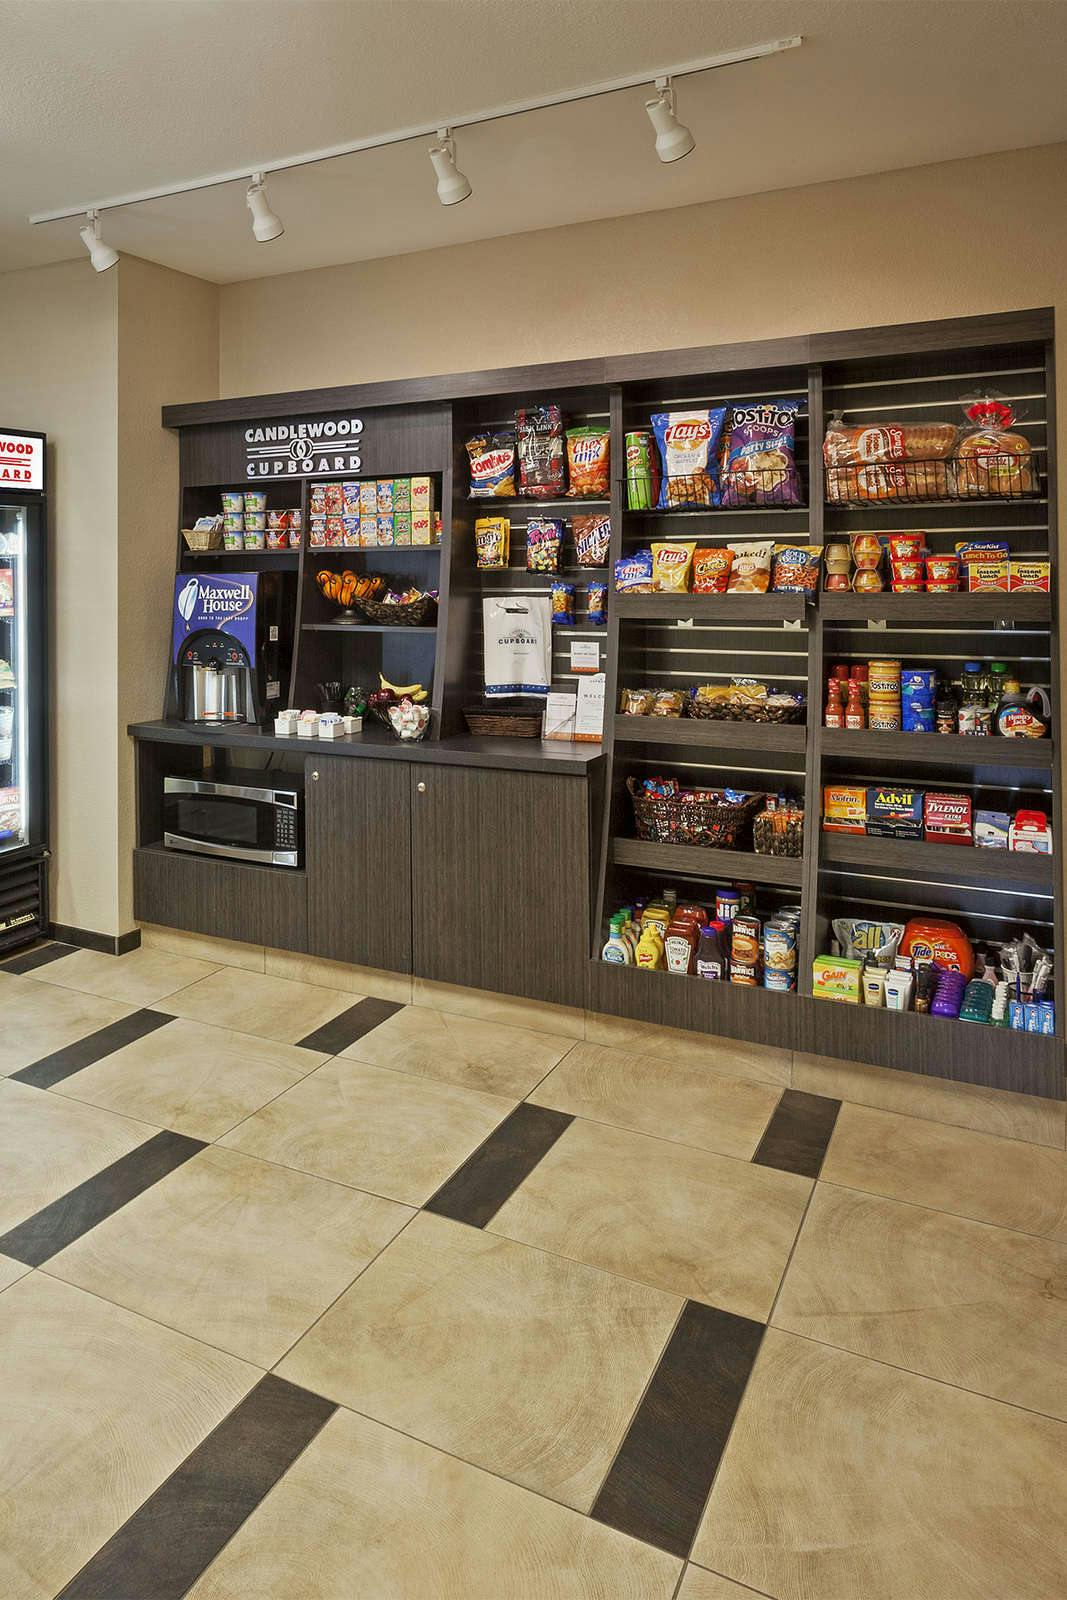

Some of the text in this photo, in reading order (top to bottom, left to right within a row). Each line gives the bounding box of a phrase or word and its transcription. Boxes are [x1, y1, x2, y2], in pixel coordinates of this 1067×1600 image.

[245, 419, 363, 442] CANDLEWOOD
[246, 456, 361, 475] CUPBOARD
[961, 552, 984, 560] Lunch
[198, 585, 250, 600] Maxwell
[203, 600, 243, 613] House
[871, 681, 899, 690] TOSTITOS
[875, 792, 914, 805] Advil
[928, 802, 968, 815] TYLENOL
[852, 926, 883, 951] all
[912, 945, 933, 957] Tide
[934, 949, 958, 960] PODS
